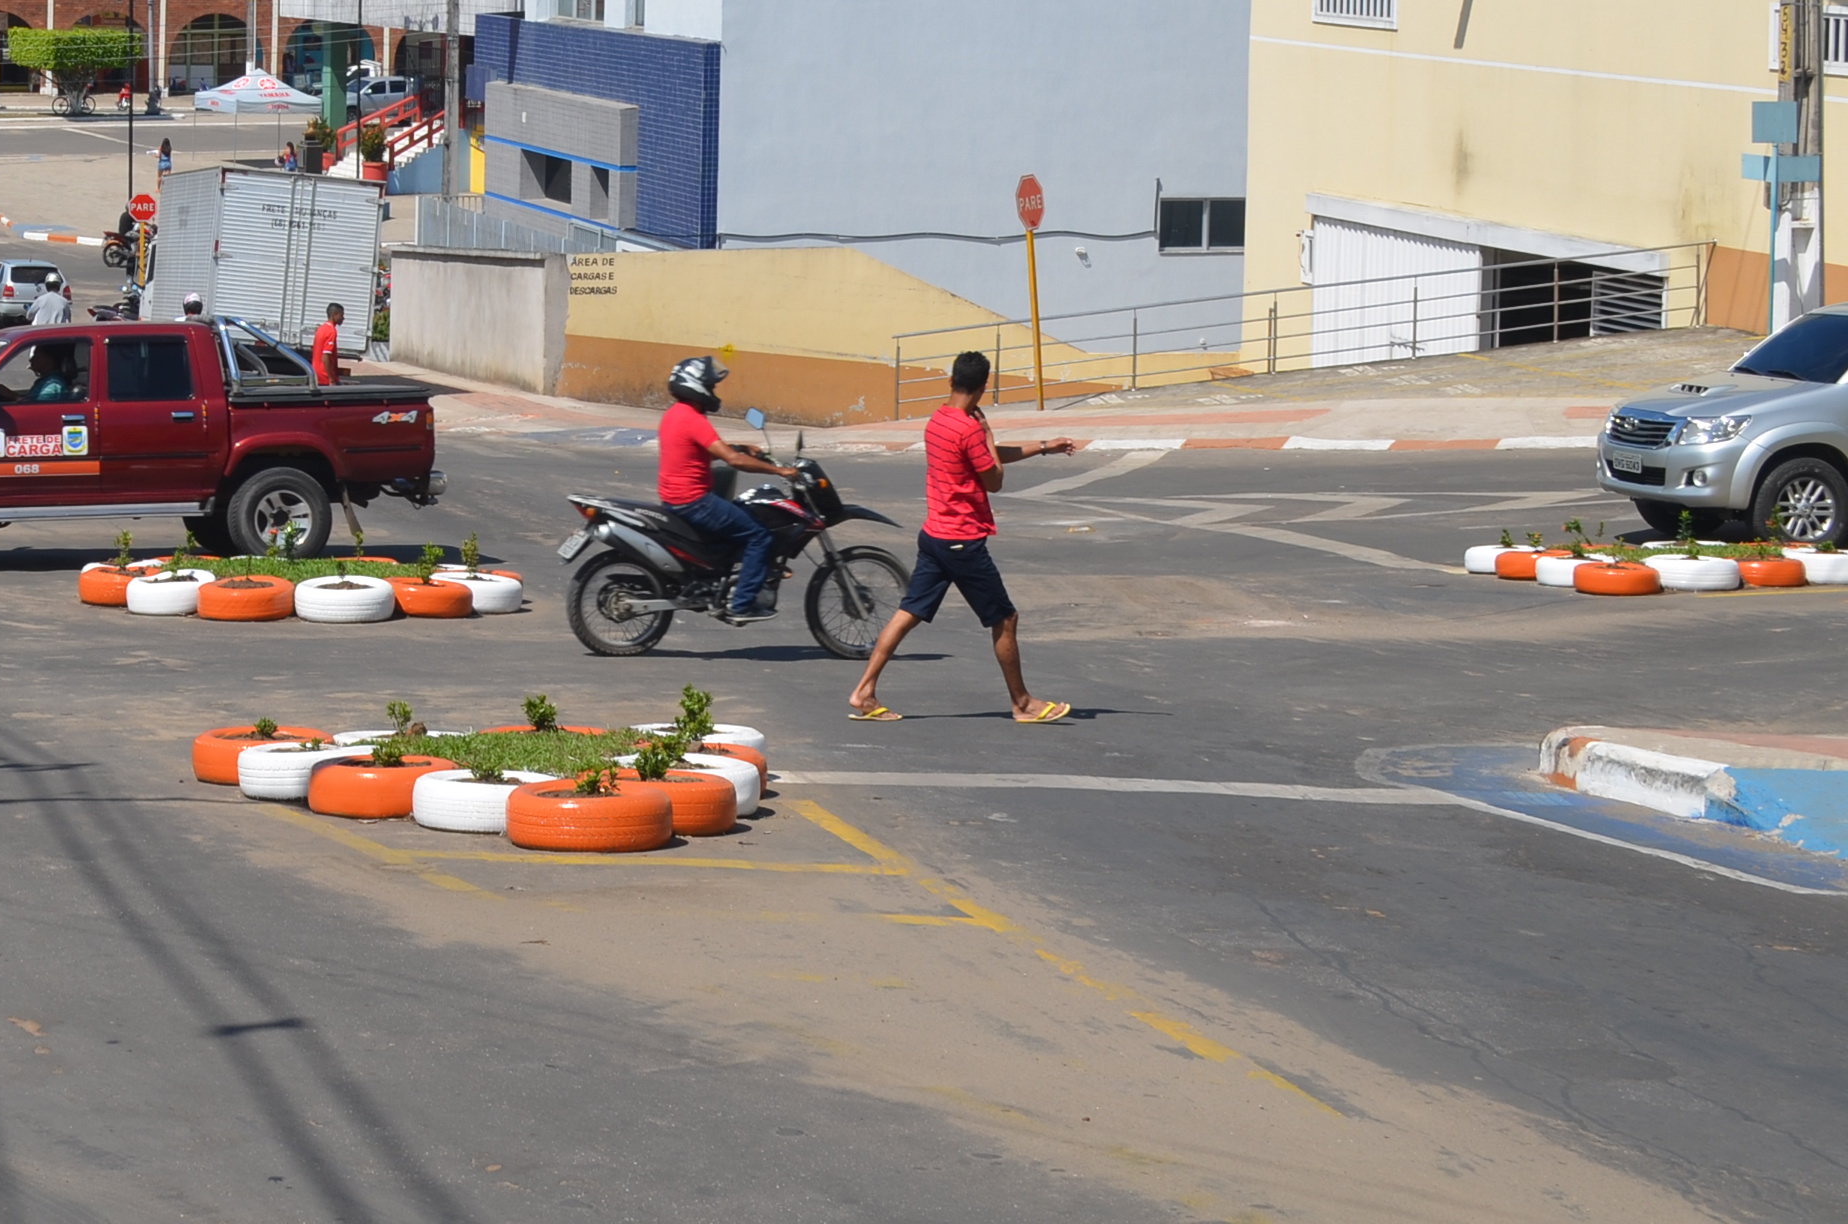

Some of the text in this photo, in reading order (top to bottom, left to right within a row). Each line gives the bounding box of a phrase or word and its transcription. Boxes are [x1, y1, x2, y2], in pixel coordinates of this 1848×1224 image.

[130, 203, 155, 212] PARE
[1018, 194, 1043, 213] PARE
[570, 255, 615, 267] ÁREA DE
[570, 272, 615, 281] CARGAS E
[569, 286, 618, 295] DESCARGAS
[6, 435, 61, 445] FRETE DE
[5, 443, 63, 457] CARGA
[14, 464, 40, 475] 068
